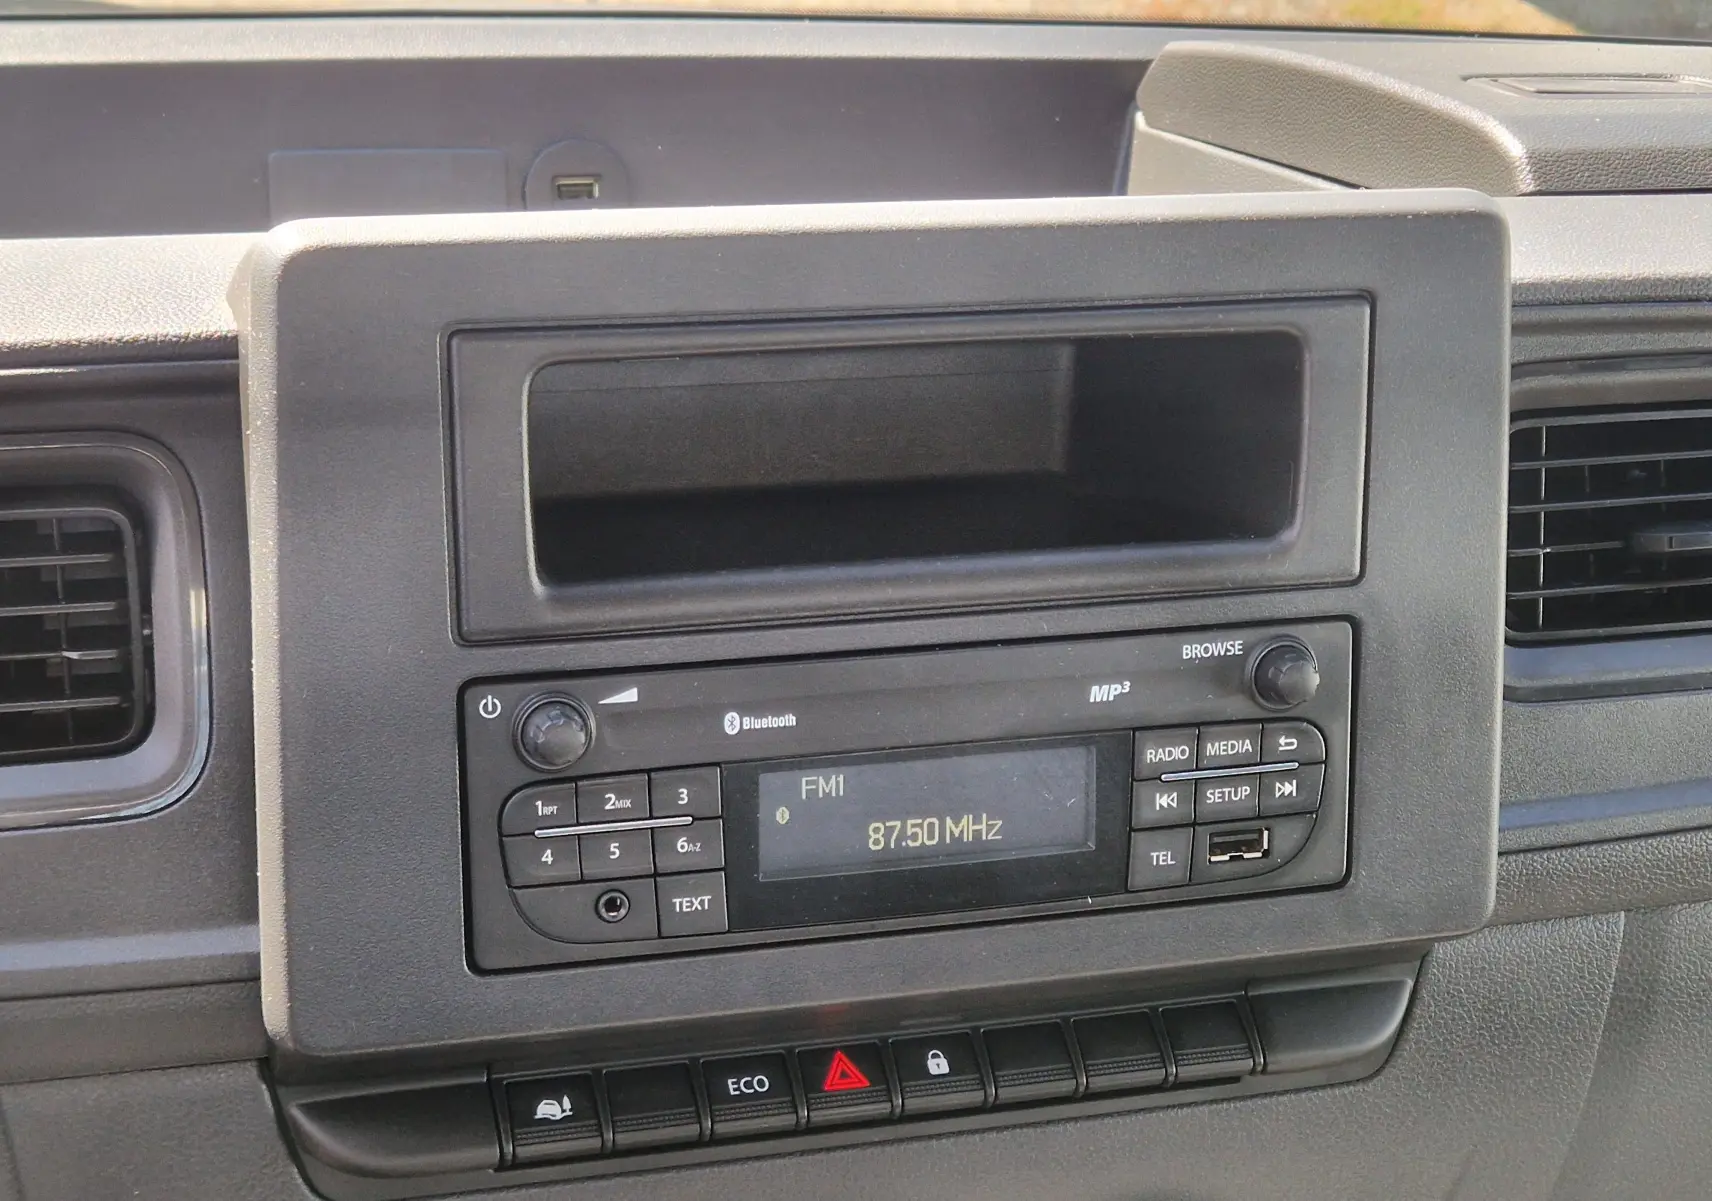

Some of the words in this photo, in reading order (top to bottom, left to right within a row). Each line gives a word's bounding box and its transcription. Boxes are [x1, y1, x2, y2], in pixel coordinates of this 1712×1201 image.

[1182, 640, 1244, 660] BROWSE
[742, 713, 797, 731] Bluetooth
[1146, 745, 1190, 763] RADIO
[1206, 738, 1253, 757] MEDIA
[801, 773, 844, 800] FM1
[1206, 786, 1251, 804] SETUP
[677, 787, 689, 805] 3
[868, 817, 940, 851] 87.50
[945, 813, 1003, 845] MHz
[541, 848, 554, 865] 4
[609, 842, 620, 859] 5
[1150, 850, 1176, 867] TEL
[672, 895, 712, 912] TEXT
[727, 1074, 771, 1097] ECO
